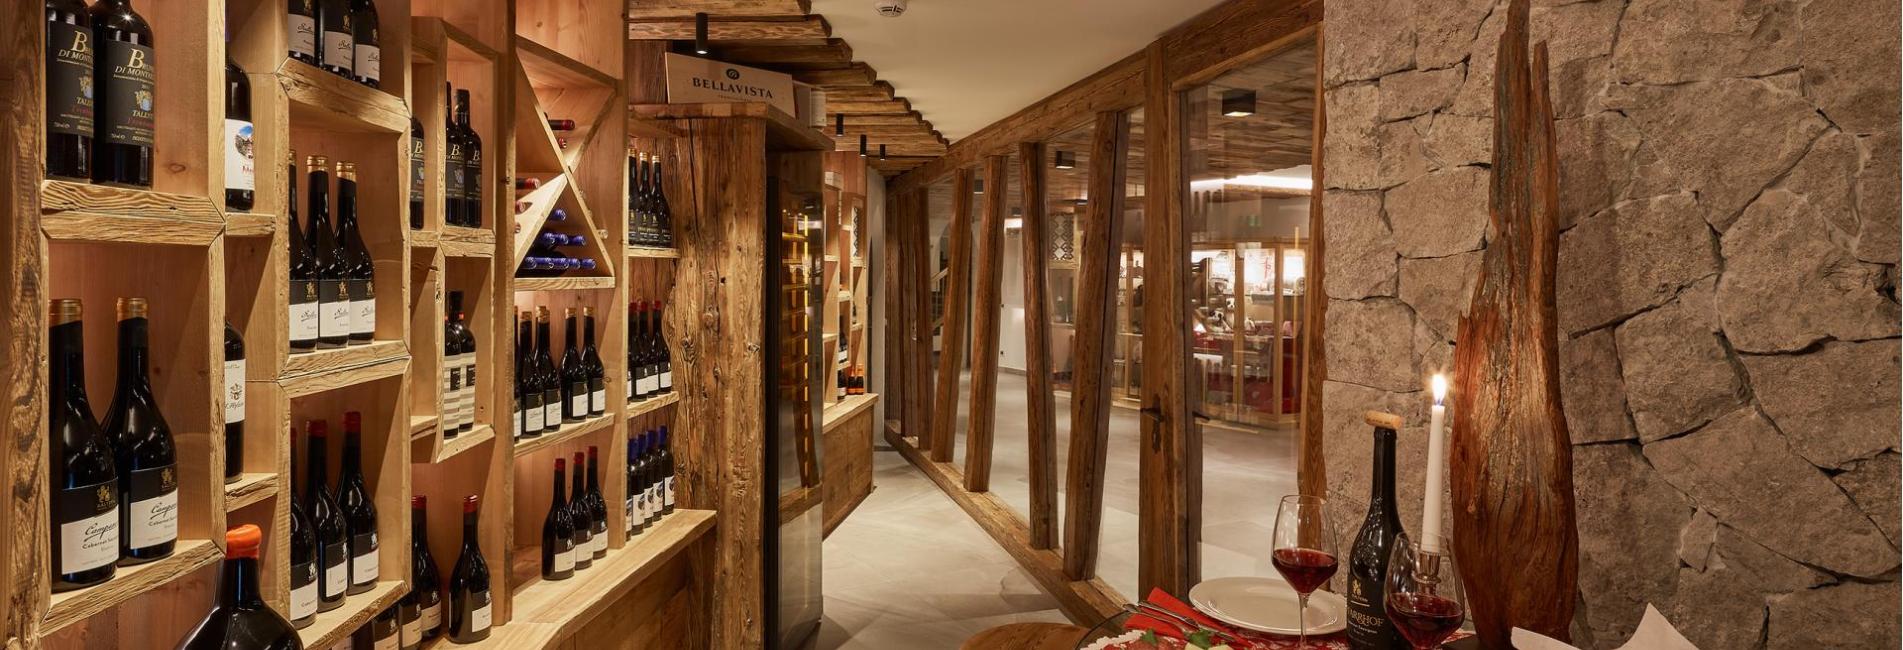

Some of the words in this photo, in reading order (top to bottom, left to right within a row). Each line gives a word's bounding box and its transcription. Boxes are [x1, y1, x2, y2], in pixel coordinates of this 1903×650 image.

[58, 49, 70, 58] DI
[114, 65, 127, 74] DI
[691, 77, 773, 98] BELLAVISTA
